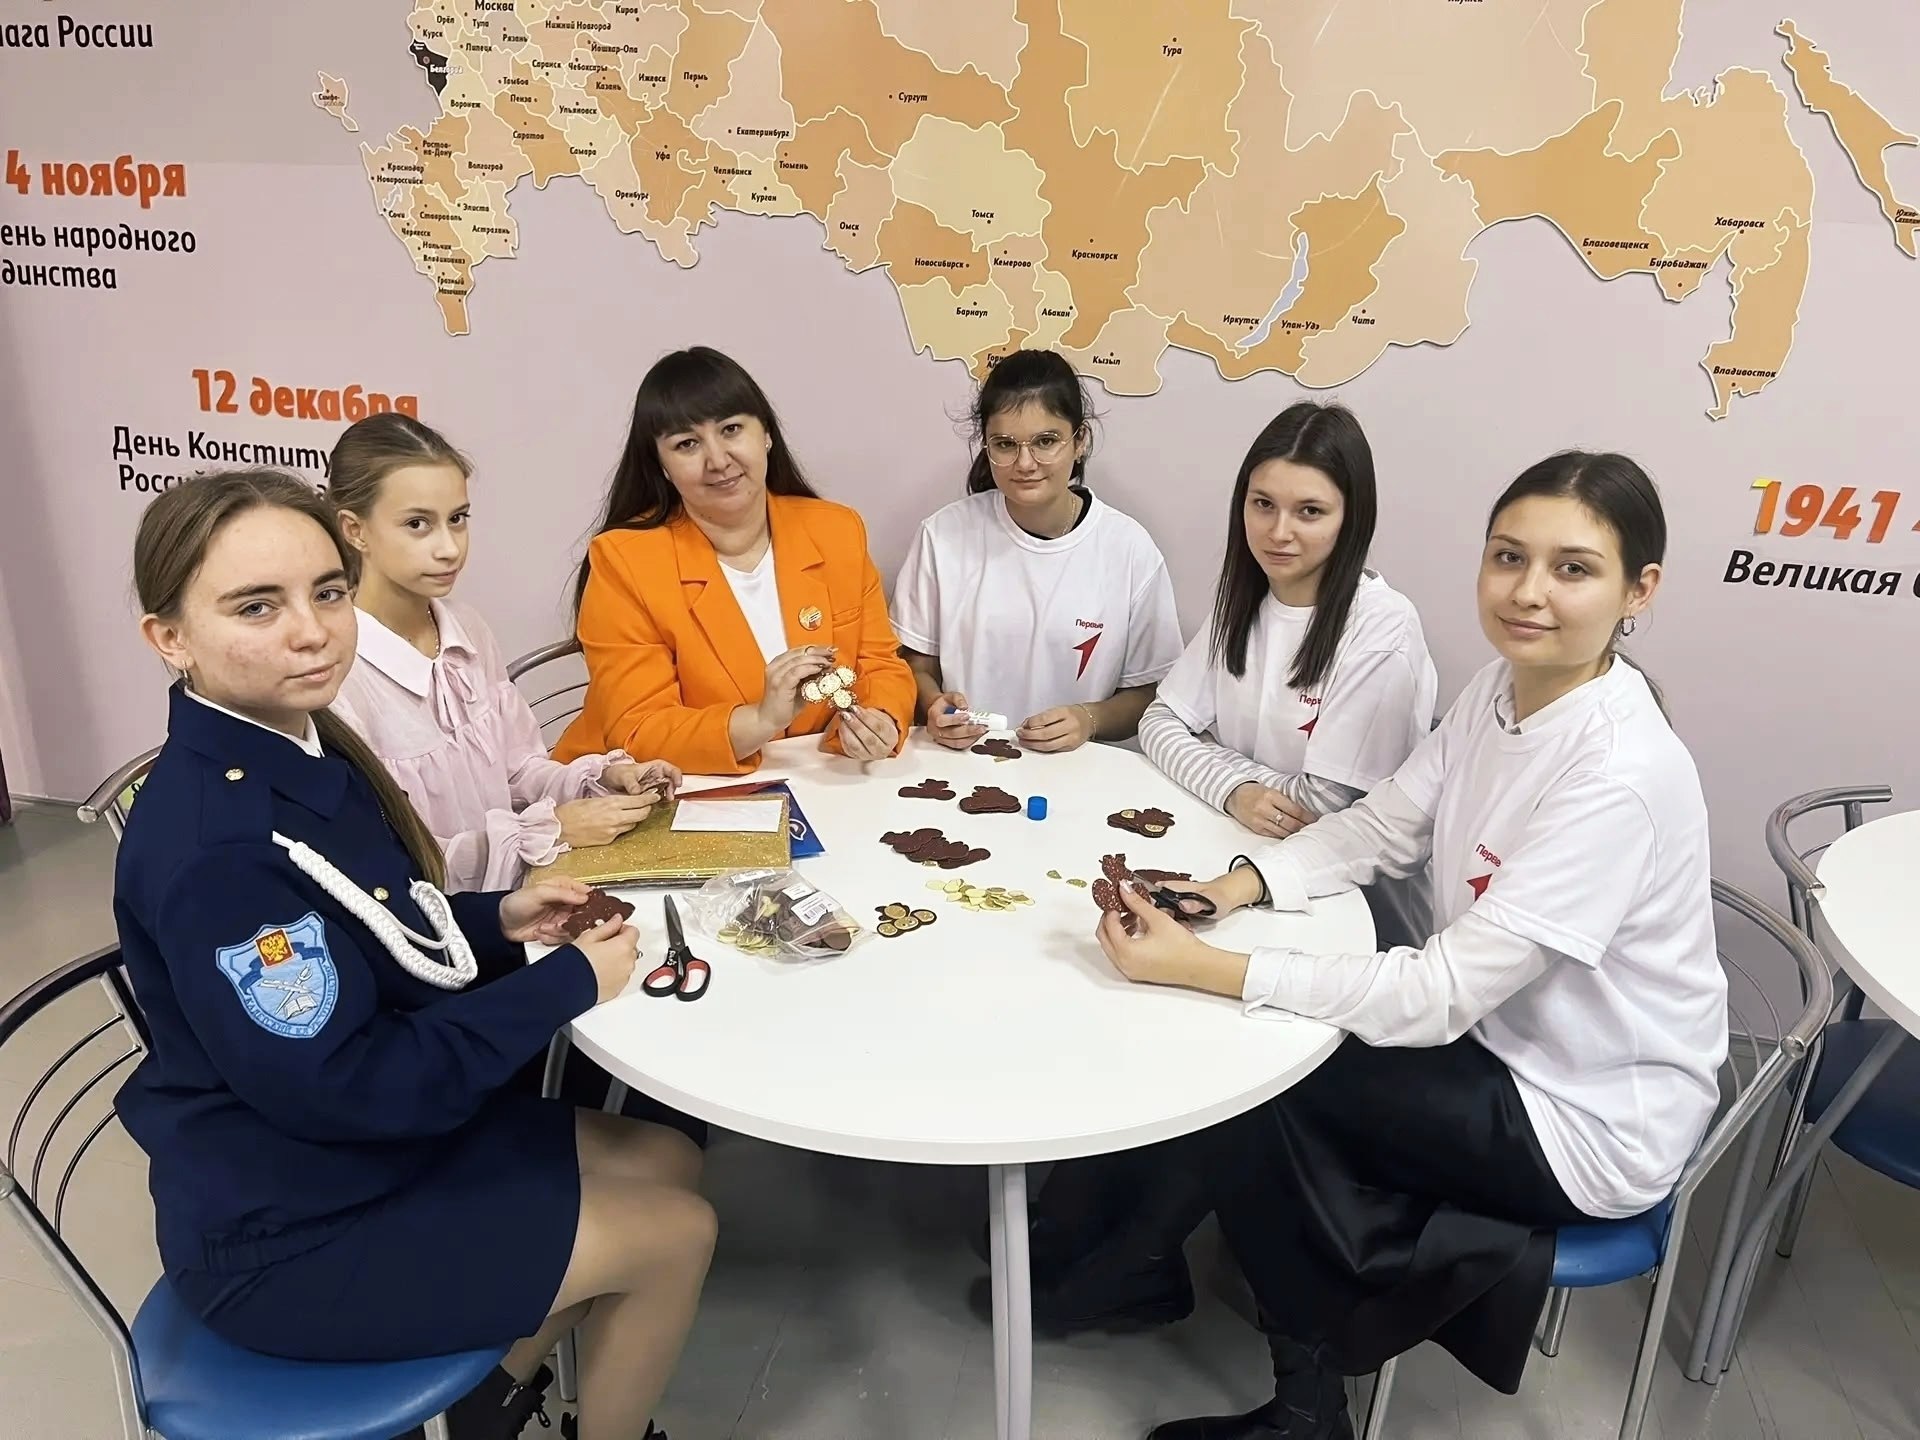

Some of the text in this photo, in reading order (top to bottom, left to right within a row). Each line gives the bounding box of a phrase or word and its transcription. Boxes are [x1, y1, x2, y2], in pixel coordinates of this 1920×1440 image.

[475, 0, 514, 11] Москва
[615, 5, 638, 15] Киров
[436, 15, 455, 25] Орёл
[472, 19, 489, 28] Тула
[57, 15, 153, 47] России
[545, 21, 612, 31] Нижний Новгород
[422, 29, 443, 39] Курск
[503, 34, 528, 43] Рязань
[466, 43, 492, 52] Липецк
[591, 42, 638, 54] Йошкар-Ола
[1162, 45, 1182, 56] Тура
[532, 60, 561, 69] Саранск
[568, 62, 608, 72] Чебоксары
[503, 77, 529, 85] Тамбов
[638, 73, 666, 82] Ижевск
[683, 72, 708, 81] Пермь
[595, 82, 622, 91] Казань
[510, 94, 532, 103] Пенза
[898, 92, 928, 103] Сургут
[450, 100, 481, 109] Воронеж
[559, 105, 597, 115] Ульяновск
[512, 131, 545, 141] Саратов
[736, 127, 790, 138] Екатеринбург
[422, 140, 451, 149] Ростов-
[569, 147, 597, 156] Самара
[655, 151, 671, 161] Уфа
[387, 162, 425, 173] Краснодар
[467, 161, 503, 171] Волгоград
[779, 160, 808, 170] Тюмень
[713, 166, 752, 176] Челябинск
[6, 150, 187, 209] 4 ноября
[376, 175, 423, 185] Новороссийск
[615, 190, 649, 200] Оренбург
[751, 192, 777, 203] Курган
[462, 203, 489, 212] Элиста
[388, 210, 405, 219] Сочи
[420, 211, 462, 221] Ставрополь
[971, 210, 995, 219] Томск
[839, 222, 860, 231] Омск
[1714, 216, 1766, 229] Хабаровск
[401, 227, 431, 236] Черкесск
[472, 225, 510, 235] Астрахань
[53, 224, 196, 256] народного
[1582, 238, 1649, 250] Благовещенск
[1071, 250, 1119, 261] Красноярск
[914, 258, 964, 270] Новосибирск
[993, 258, 1032, 268] Кемерово
[1649, 257, 1708, 270] Биробиджан
[2, 259, 117, 289] динства
[956, 307, 988, 317] Барнаул
[1041, 308, 1070, 318] Абакан
[1222, 314, 1260, 325] Иркутск
[1280, 319, 1320, 330] Улан-Удэ
[1351, 316, 1376, 325] Чита
[1092, 356, 1121, 366] Кызыл
[1712, 366, 1777, 378] Владивосток
[191, 368, 239, 413] 12
[112, 426, 180, 461] День
[1751, 478, 1902, 544] 1941
[1723, 550, 1902, 596] Великая
[1075, 618, 1104, 630] Первые
